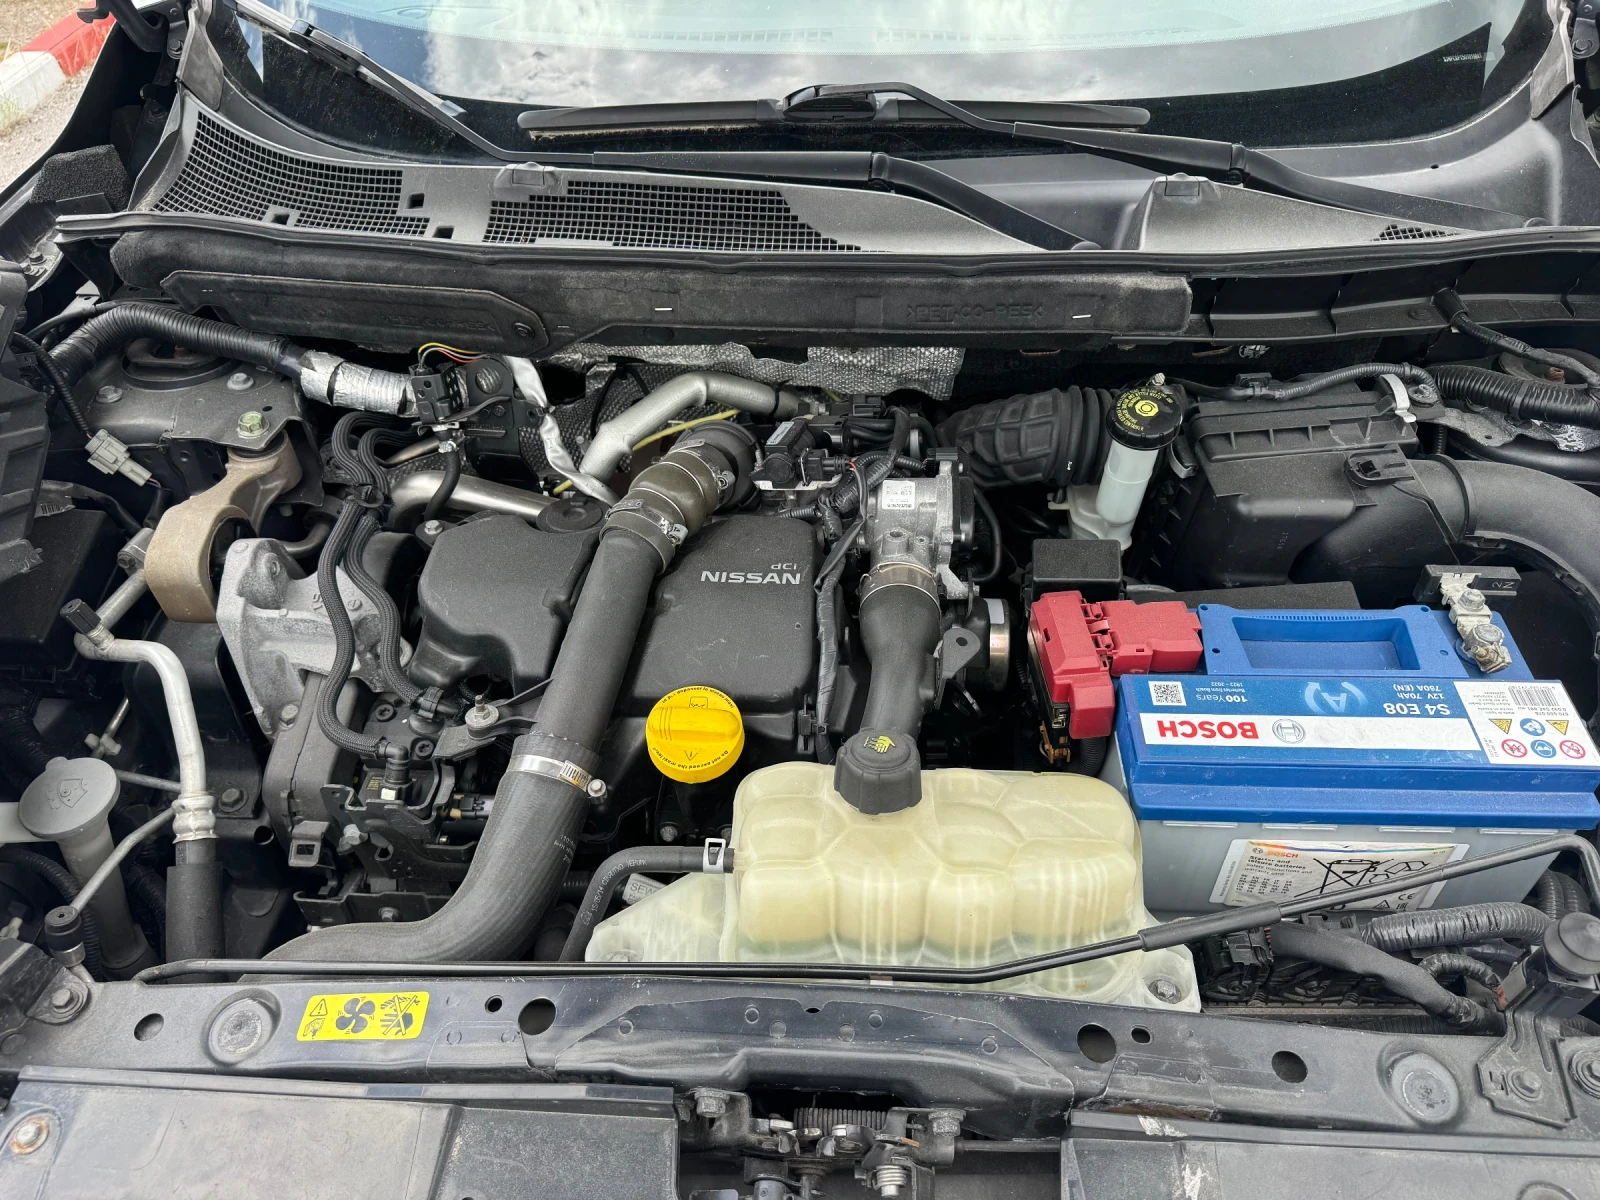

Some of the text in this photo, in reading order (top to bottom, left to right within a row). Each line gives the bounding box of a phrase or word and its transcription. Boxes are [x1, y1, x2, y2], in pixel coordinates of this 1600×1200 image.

[770, 562, 798, 570] dCi
[700, 570, 801, 585] NISSAN
[1393, 683, 1415, 692] (EN)
[1195, 694, 1248, 703] 100 Years
[1396, 692, 1445, 700] 12V 70Ah
[1383, 702, 1451, 716] S4 E08
[1156, 720, 1260, 740] BOSCH
[1267, 850, 1299, 859] BOSCH
